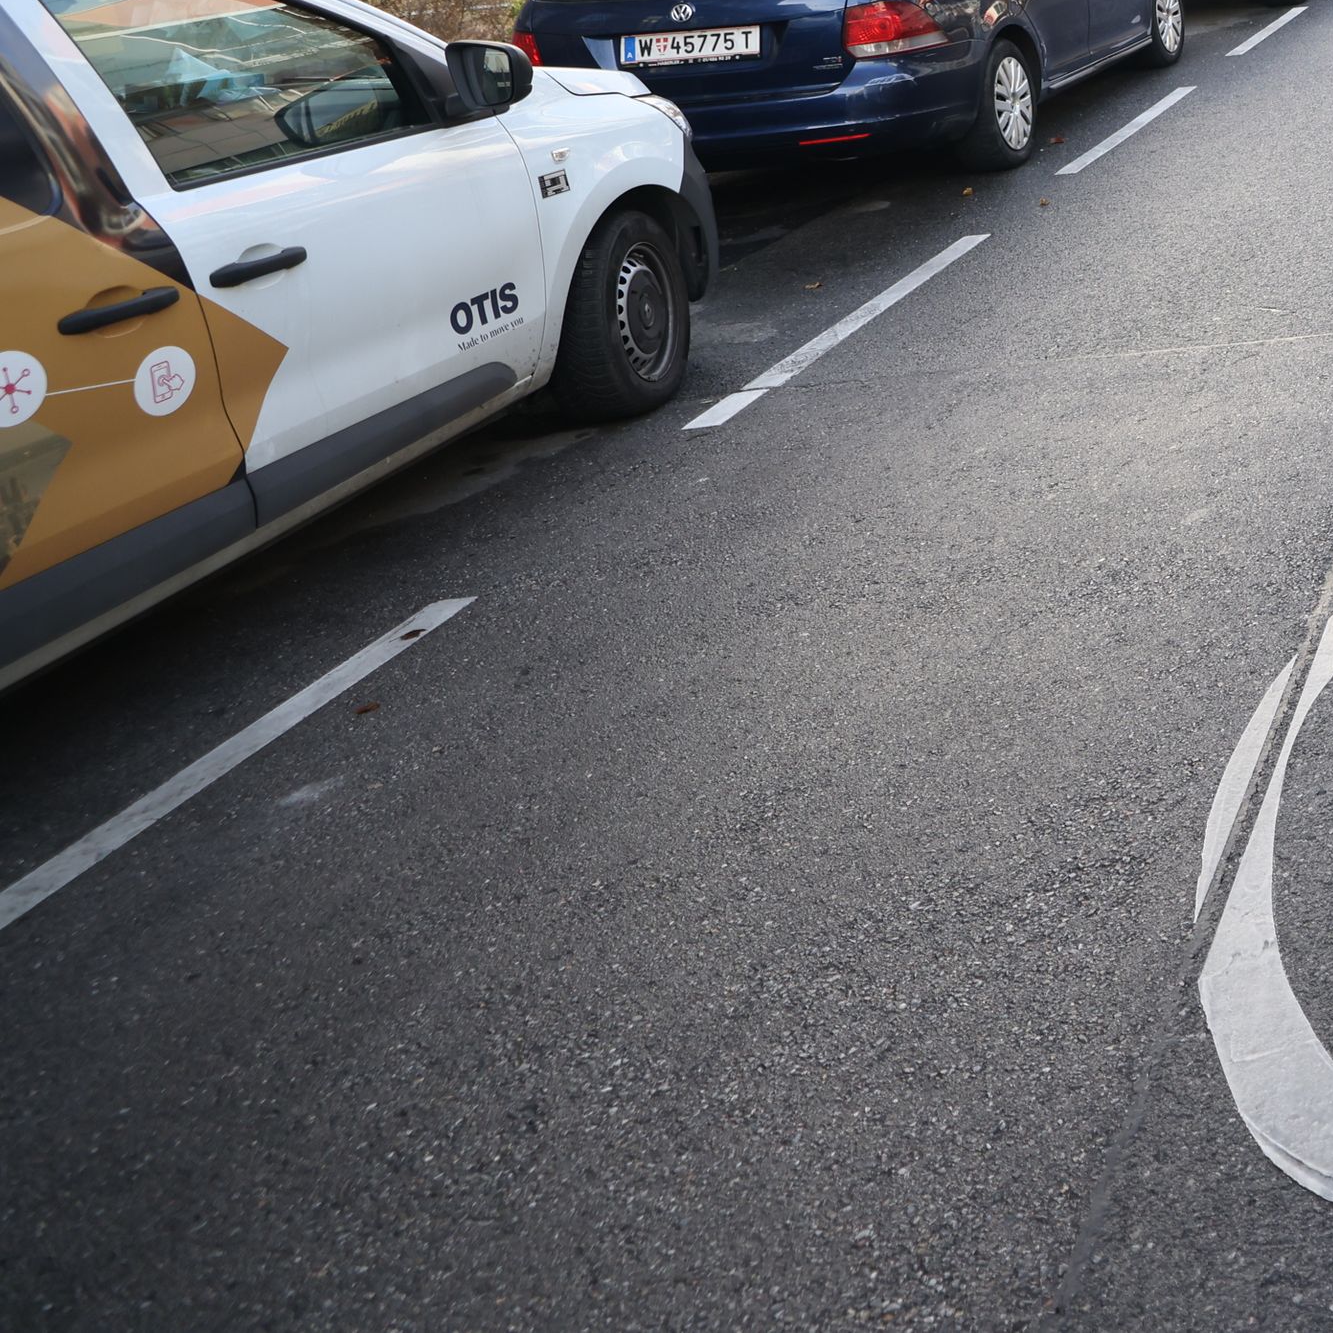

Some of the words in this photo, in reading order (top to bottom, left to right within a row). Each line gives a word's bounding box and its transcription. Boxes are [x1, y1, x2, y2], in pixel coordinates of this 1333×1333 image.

[639, 38, 653, 57] W
[670, 32, 735, 55] 45775
[741, 31, 752, 49] T
[450, 282, 519, 335] OTIS
[457, 337, 480, 352] Made
[480, 333, 489, 343] to
[489, 322, 510, 338] move
[510, 316, 524, 331] you
